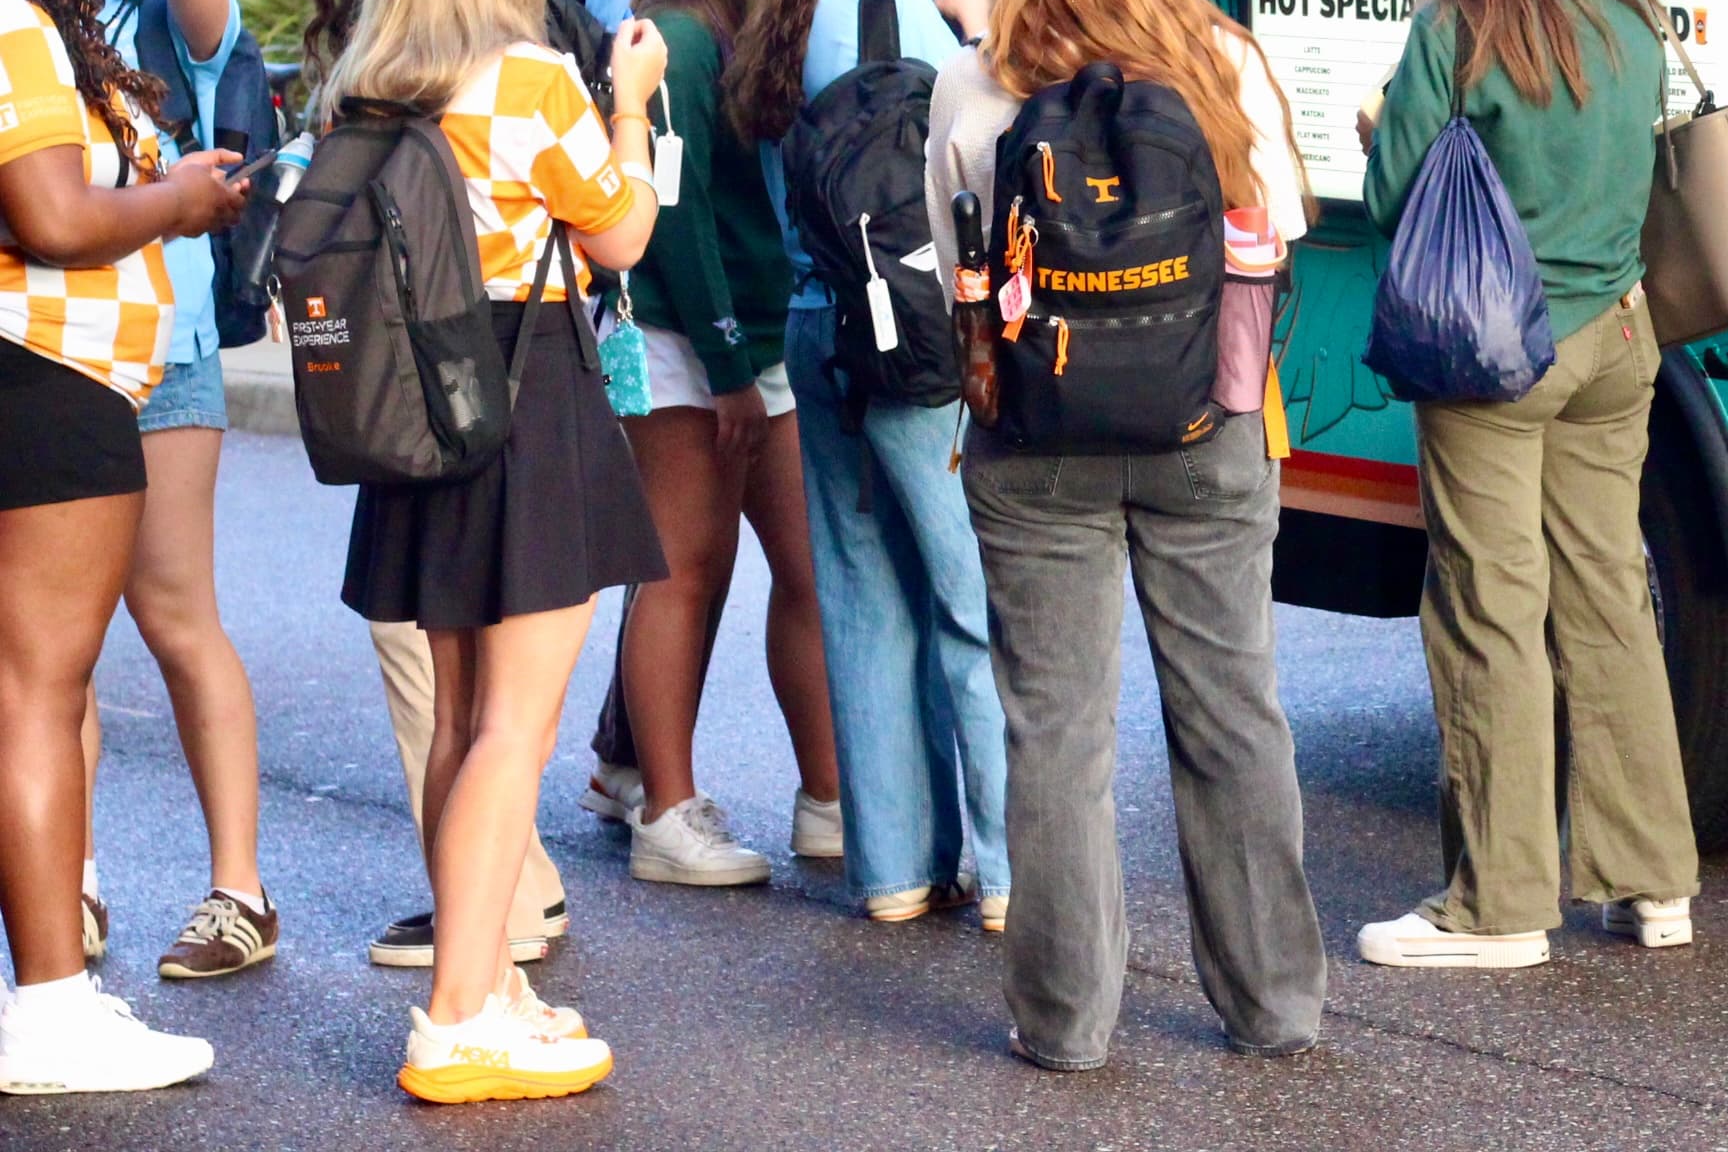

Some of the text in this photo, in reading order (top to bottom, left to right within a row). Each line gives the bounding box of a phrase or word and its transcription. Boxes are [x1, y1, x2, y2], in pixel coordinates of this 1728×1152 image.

[1301, 153, 1331, 163] MERICANO
[1086, 176, 1121, 202] T
[1037, 255, 1191, 293] TENNESSEE
[293, 318, 347, 334] FIRST-YEAR
[293, 330, 350, 346] EXPERIENCE
[449, 1043, 512, 1069] HOKA
